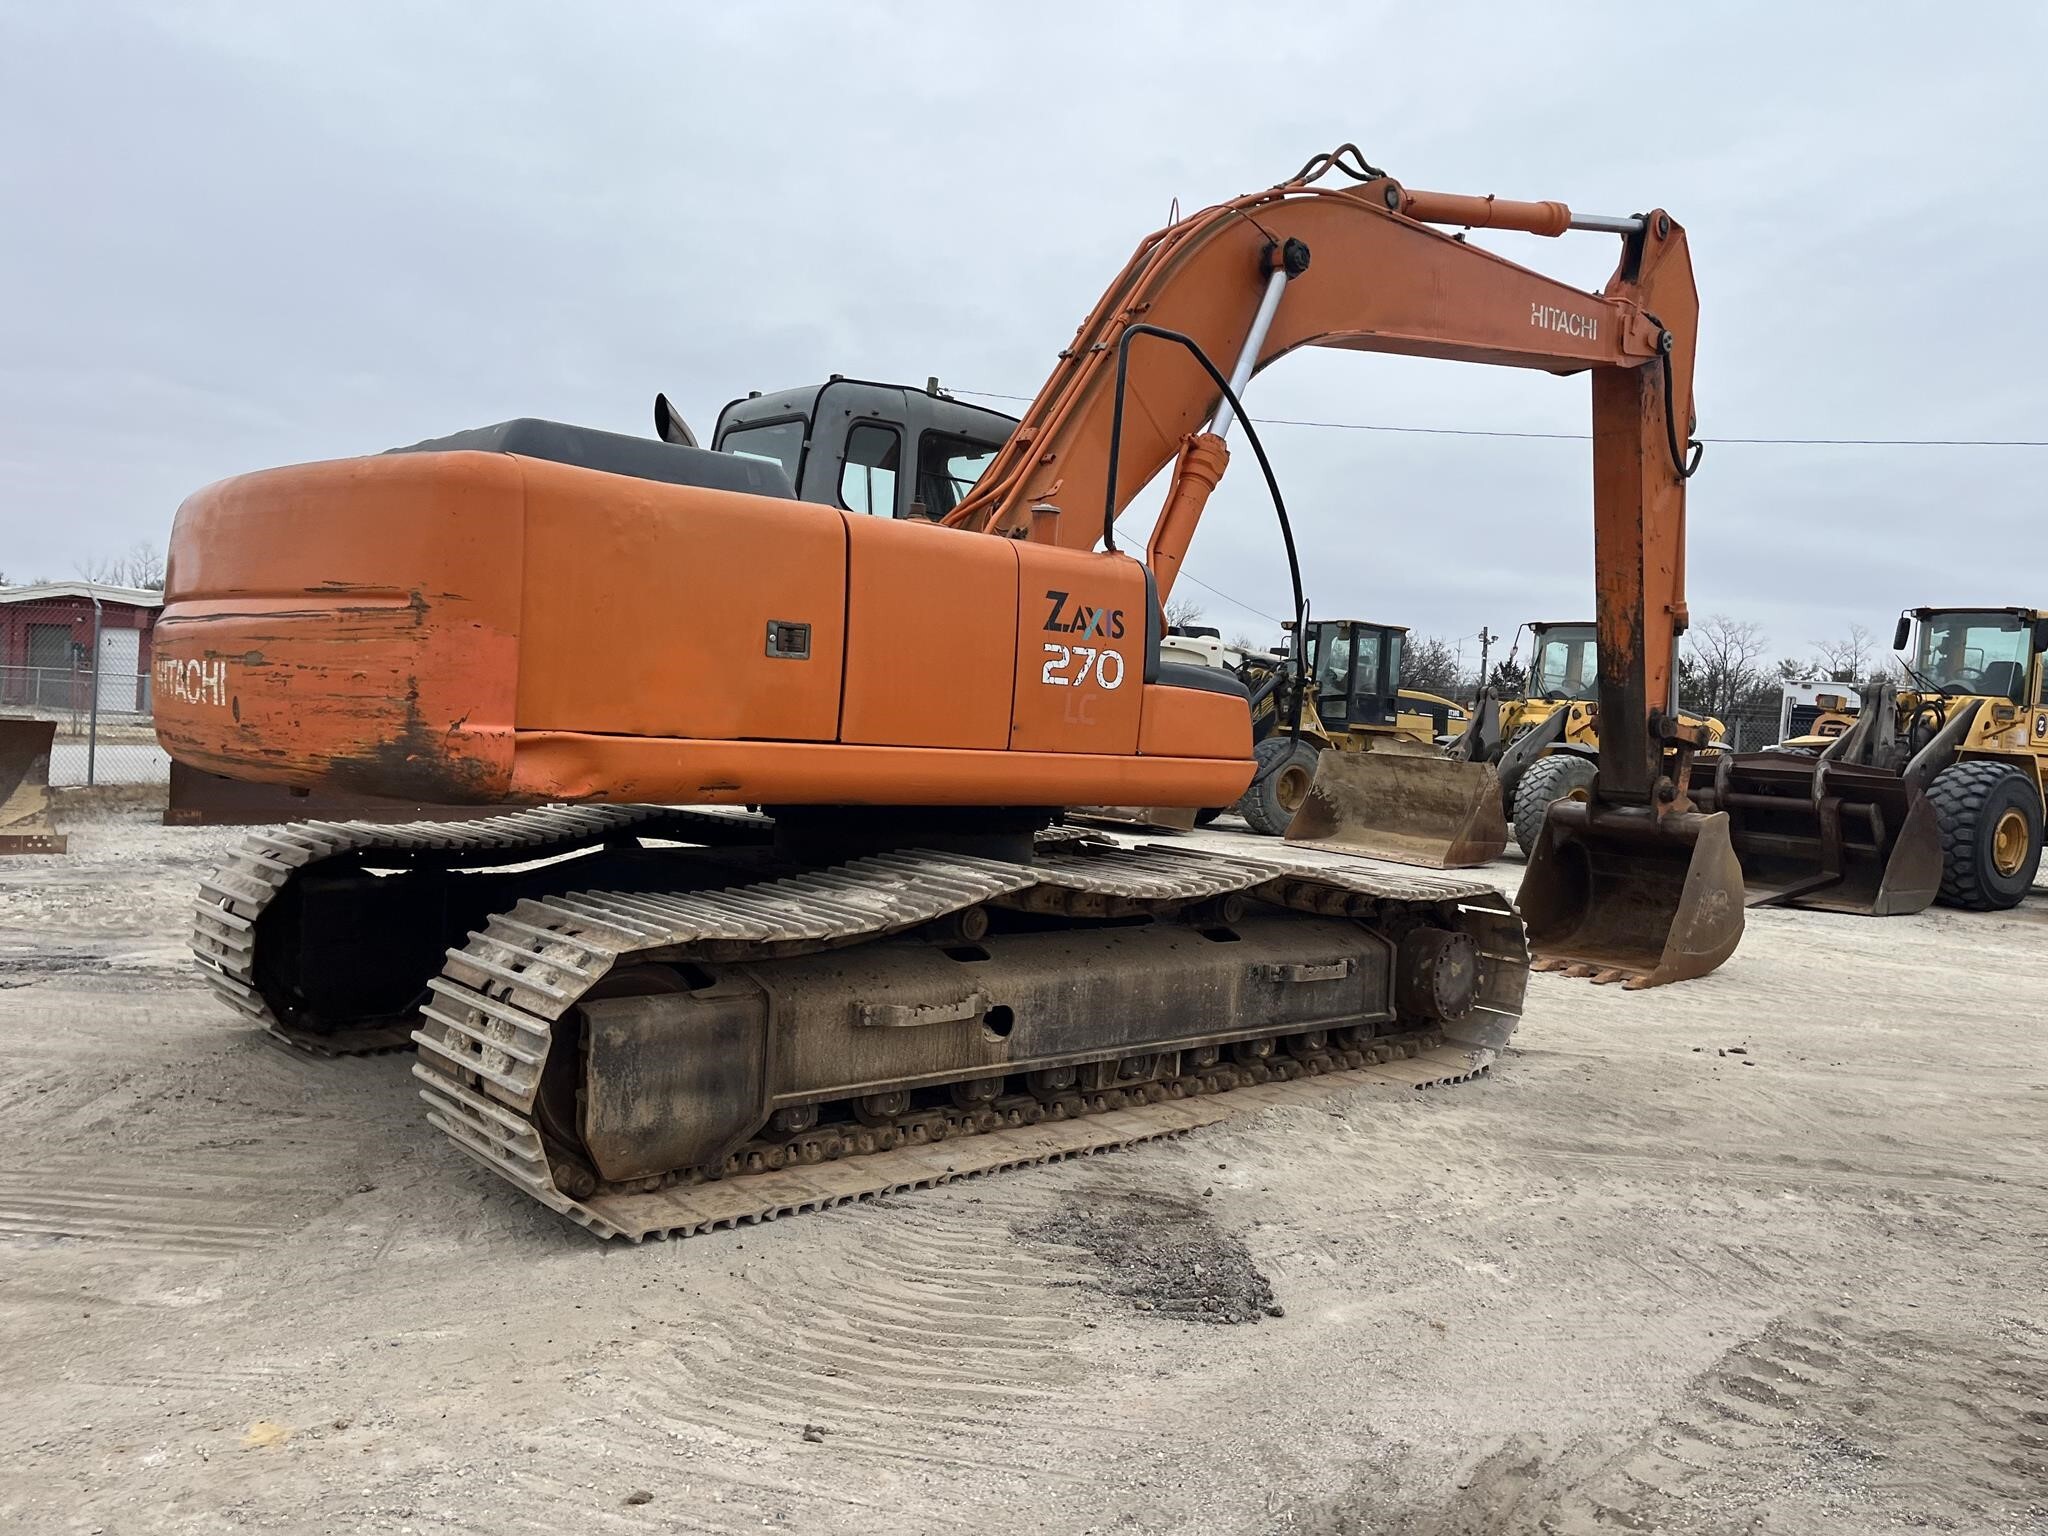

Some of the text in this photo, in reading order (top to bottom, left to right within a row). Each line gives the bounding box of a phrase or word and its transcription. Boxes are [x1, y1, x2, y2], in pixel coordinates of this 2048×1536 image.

[1531, 302, 1597, 340] HITACHI
[1043, 590, 1125, 639] ZAXIS
[157, 659, 226, 706] HITACHI
[1042, 643, 1124, 690] 270
[1064, 692, 1097, 725] LC
